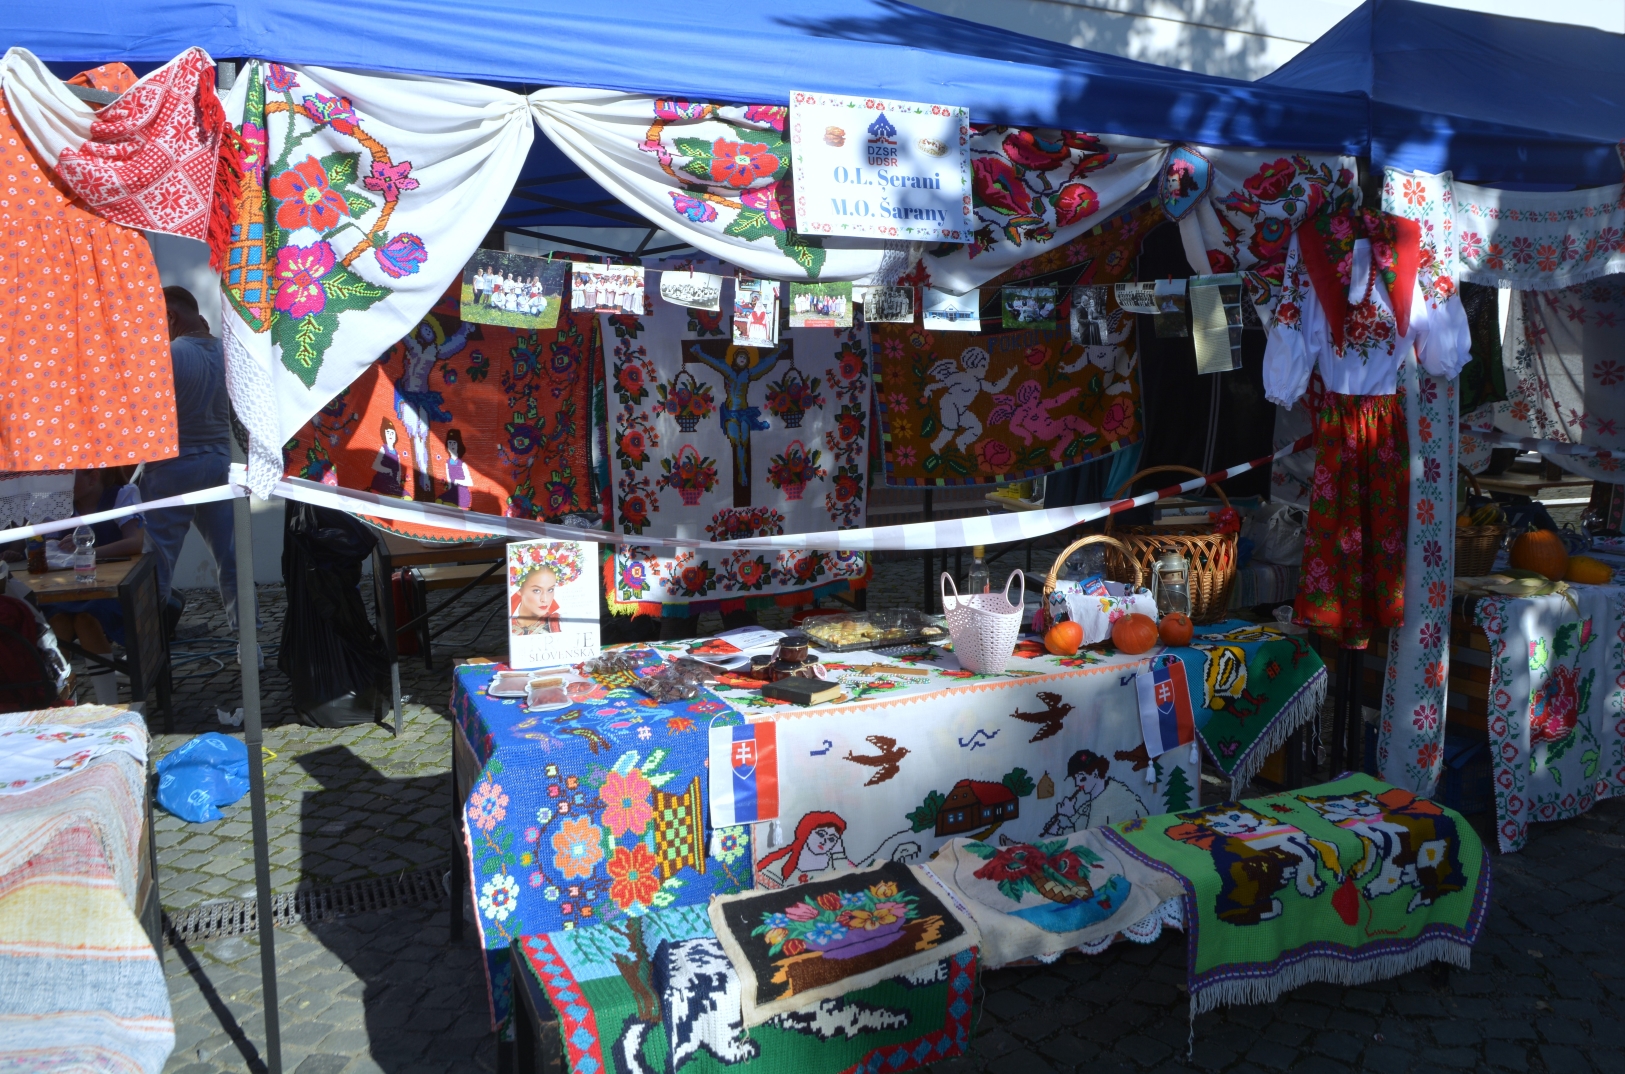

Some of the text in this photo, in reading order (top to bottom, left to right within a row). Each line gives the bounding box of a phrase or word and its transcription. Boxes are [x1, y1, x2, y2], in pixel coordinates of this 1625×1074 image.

[867, 145, 898, 157] DZSR
[868, 156, 899, 167] UDSR
[833, 165, 873, 186] O.L.
[830, 196, 948, 227] M.O. Šarany
[529, 648, 595, 663] SLOVENSKA
